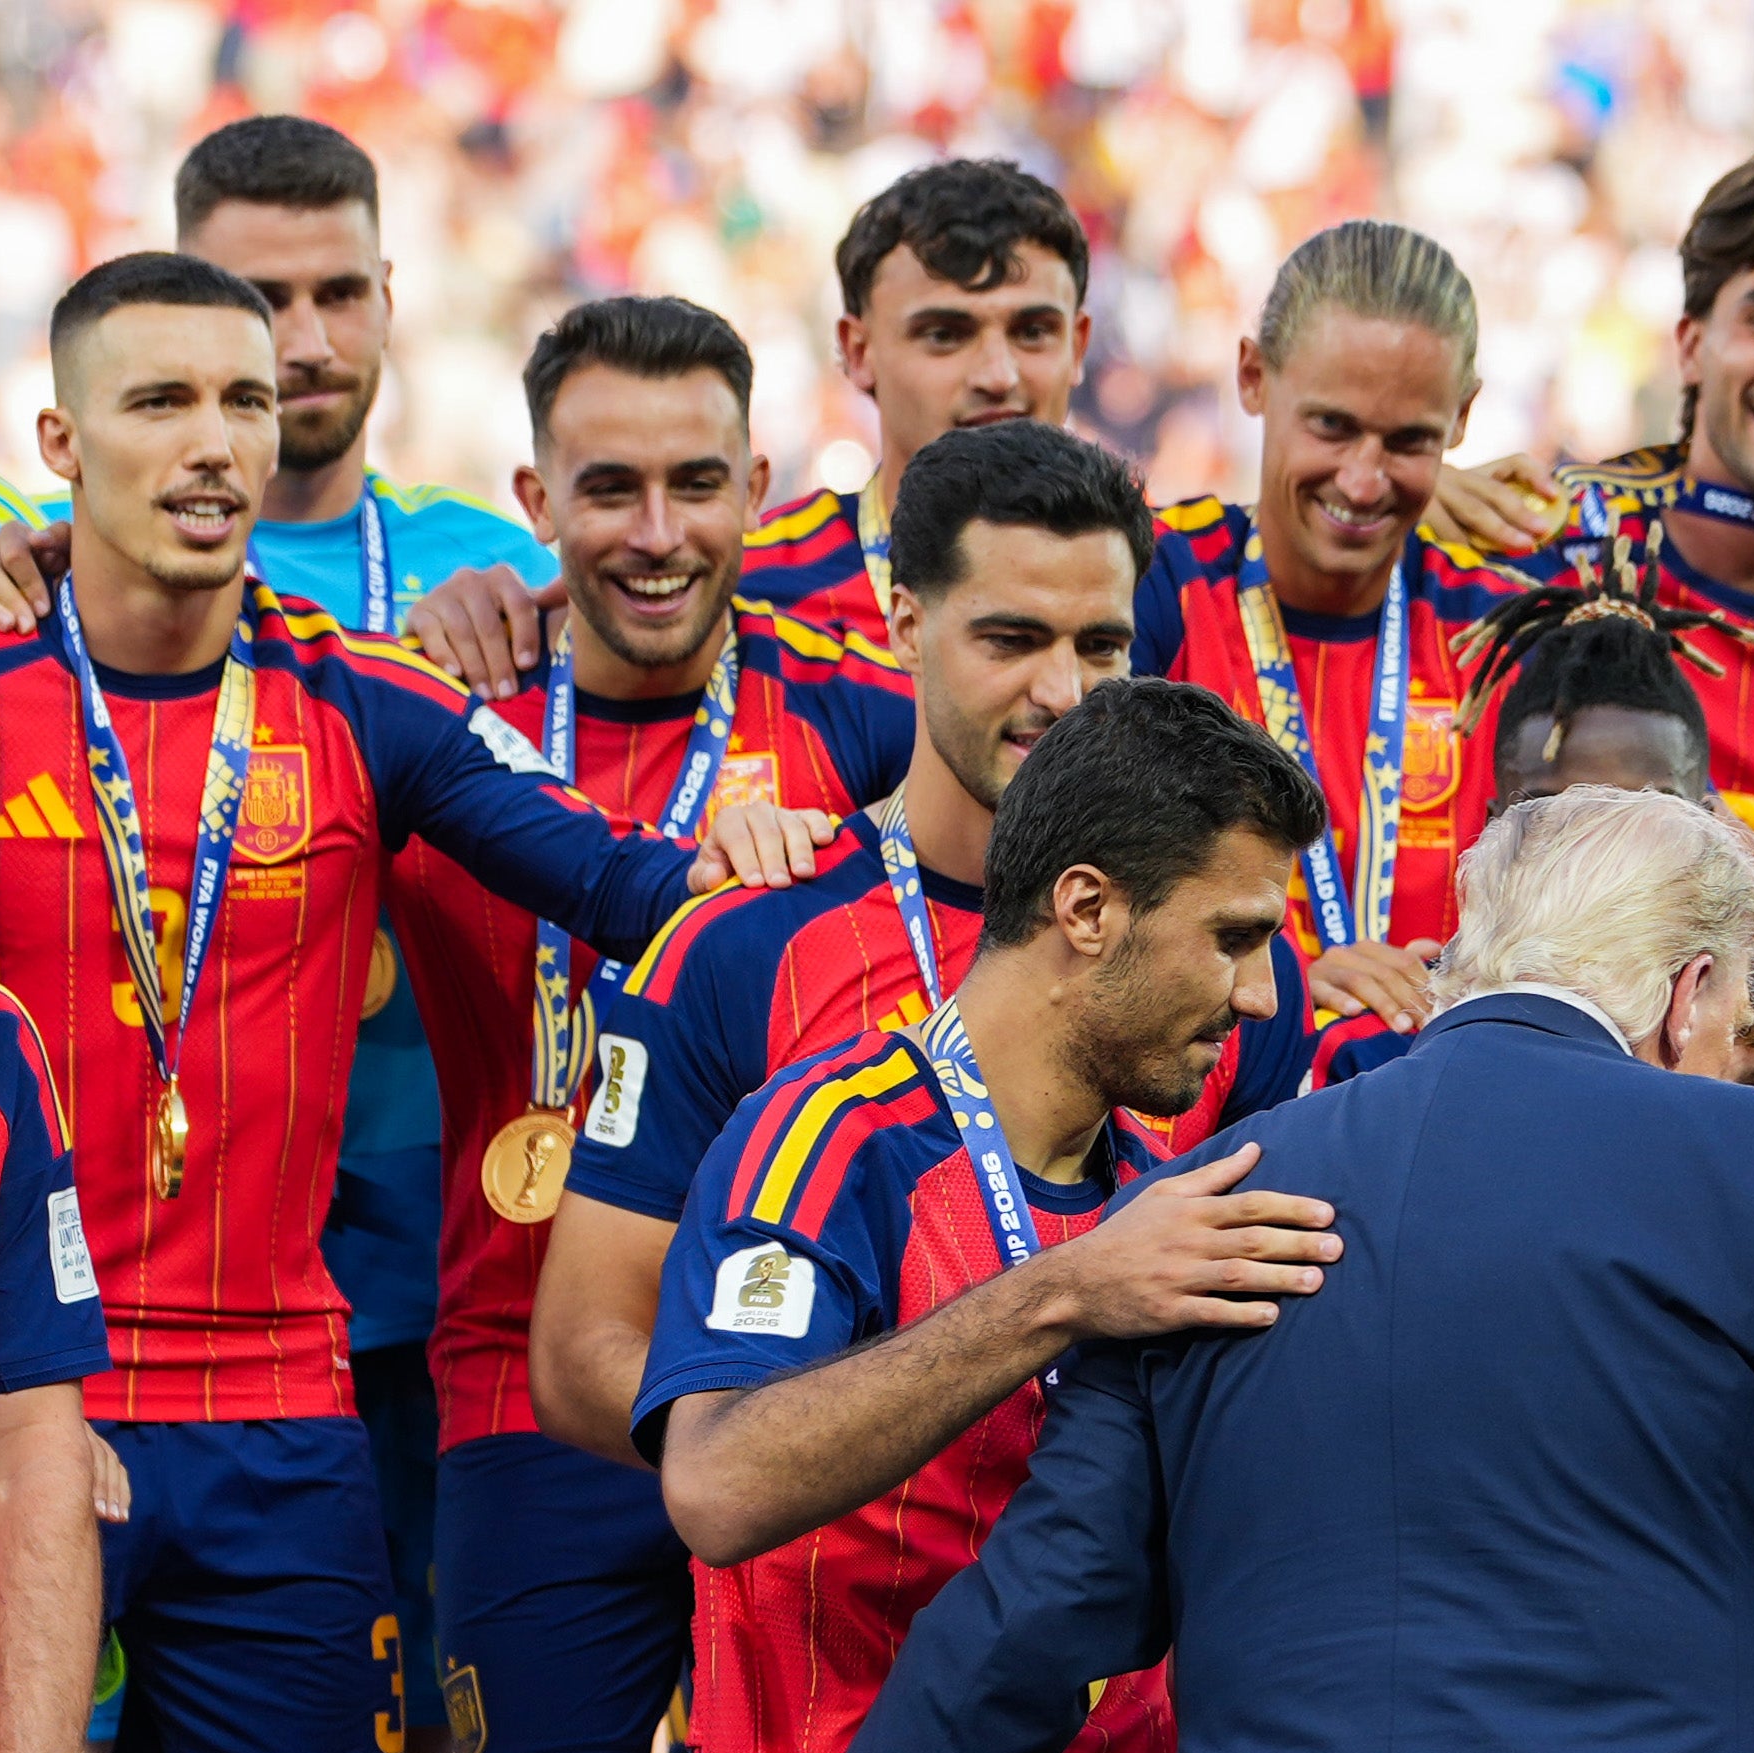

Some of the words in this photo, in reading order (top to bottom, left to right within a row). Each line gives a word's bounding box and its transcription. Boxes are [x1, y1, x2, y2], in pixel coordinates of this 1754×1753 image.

[1383, 604, 1402, 675] WORLD
[553, 684, 568, 733] FIFA
[1379, 675, 1400, 722] FIFA
[550, 733, 568, 779] WOR
[670, 751, 711, 826] 2026
[195, 858, 219, 909] FIFA
[1308, 836, 1336, 901] ORLD
[188, 905, 210, 978] WORLD
[910, 915, 934, 989] 2026
[981, 1151, 1022, 1232] 2026
[59, 1224, 83, 1248] UNITE
[1006, 1229, 1030, 1266] UP
[732, 1316, 779, 1328] 2026
[736, 1310, 765, 1318] WORLD
[749, 1294, 772, 1304] FIFA
